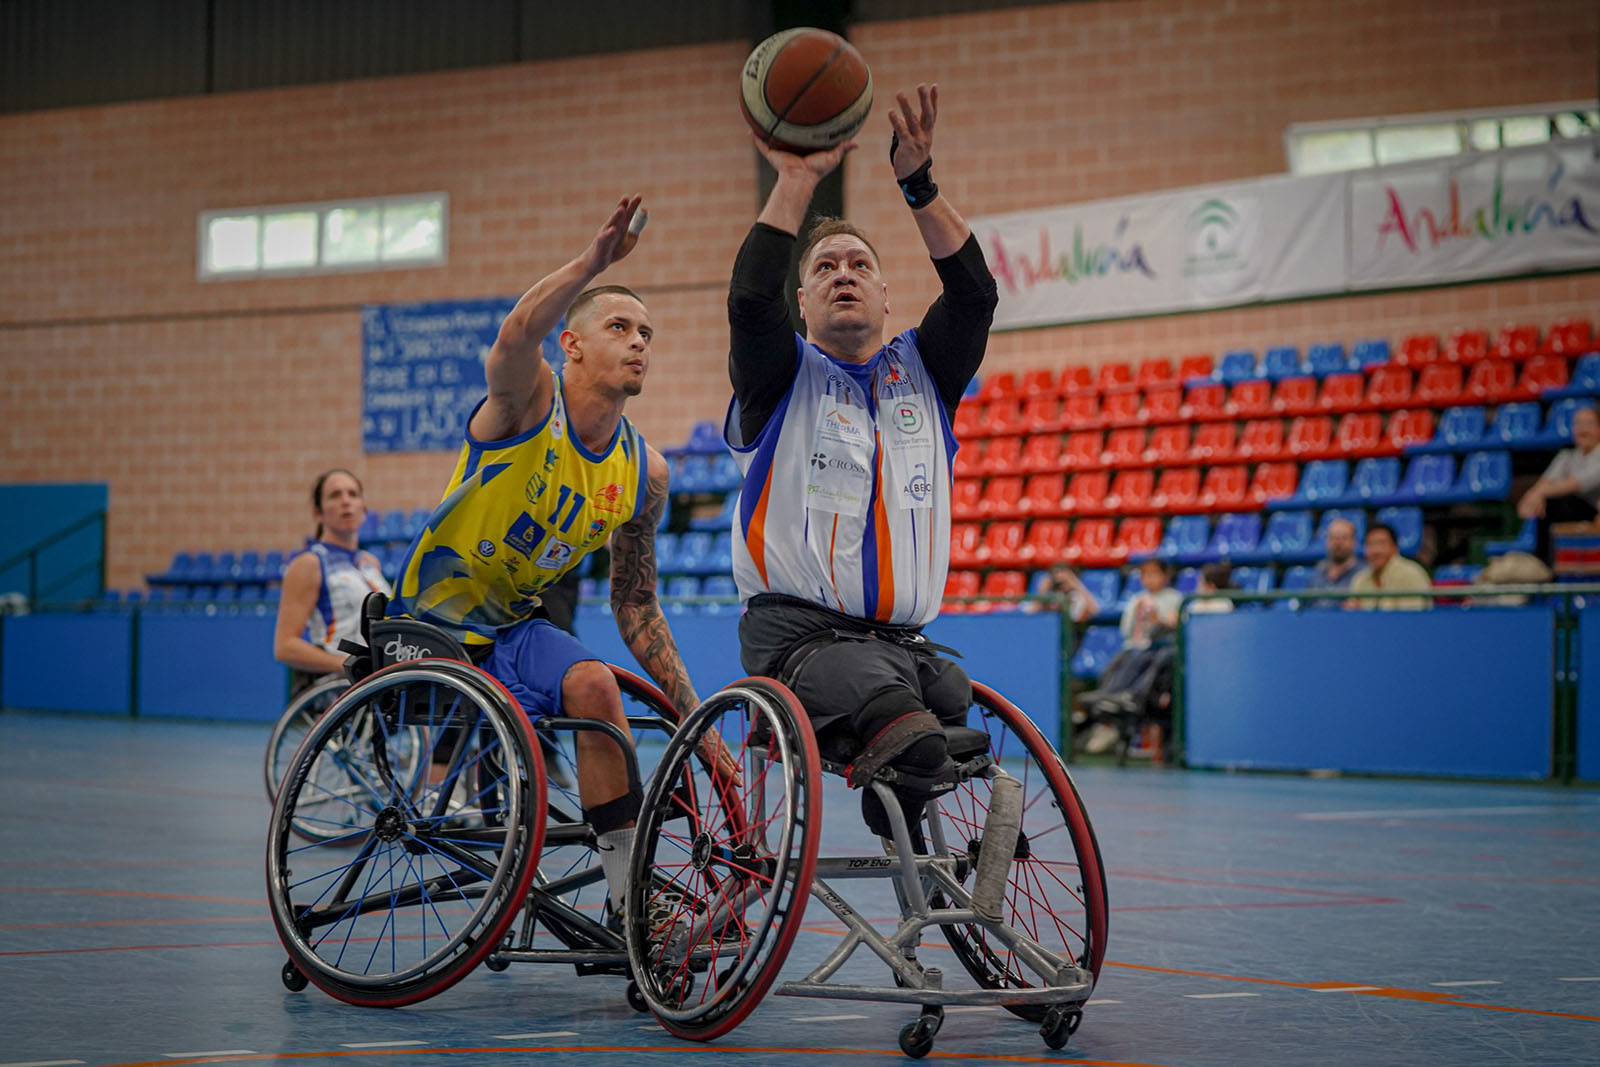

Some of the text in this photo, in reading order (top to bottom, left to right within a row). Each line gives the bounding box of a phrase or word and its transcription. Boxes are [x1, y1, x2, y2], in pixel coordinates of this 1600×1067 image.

[828, 458, 867, 474] CROSS
[548, 484, 586, 534] 11
[848, 858, 892, 868] TOP END
